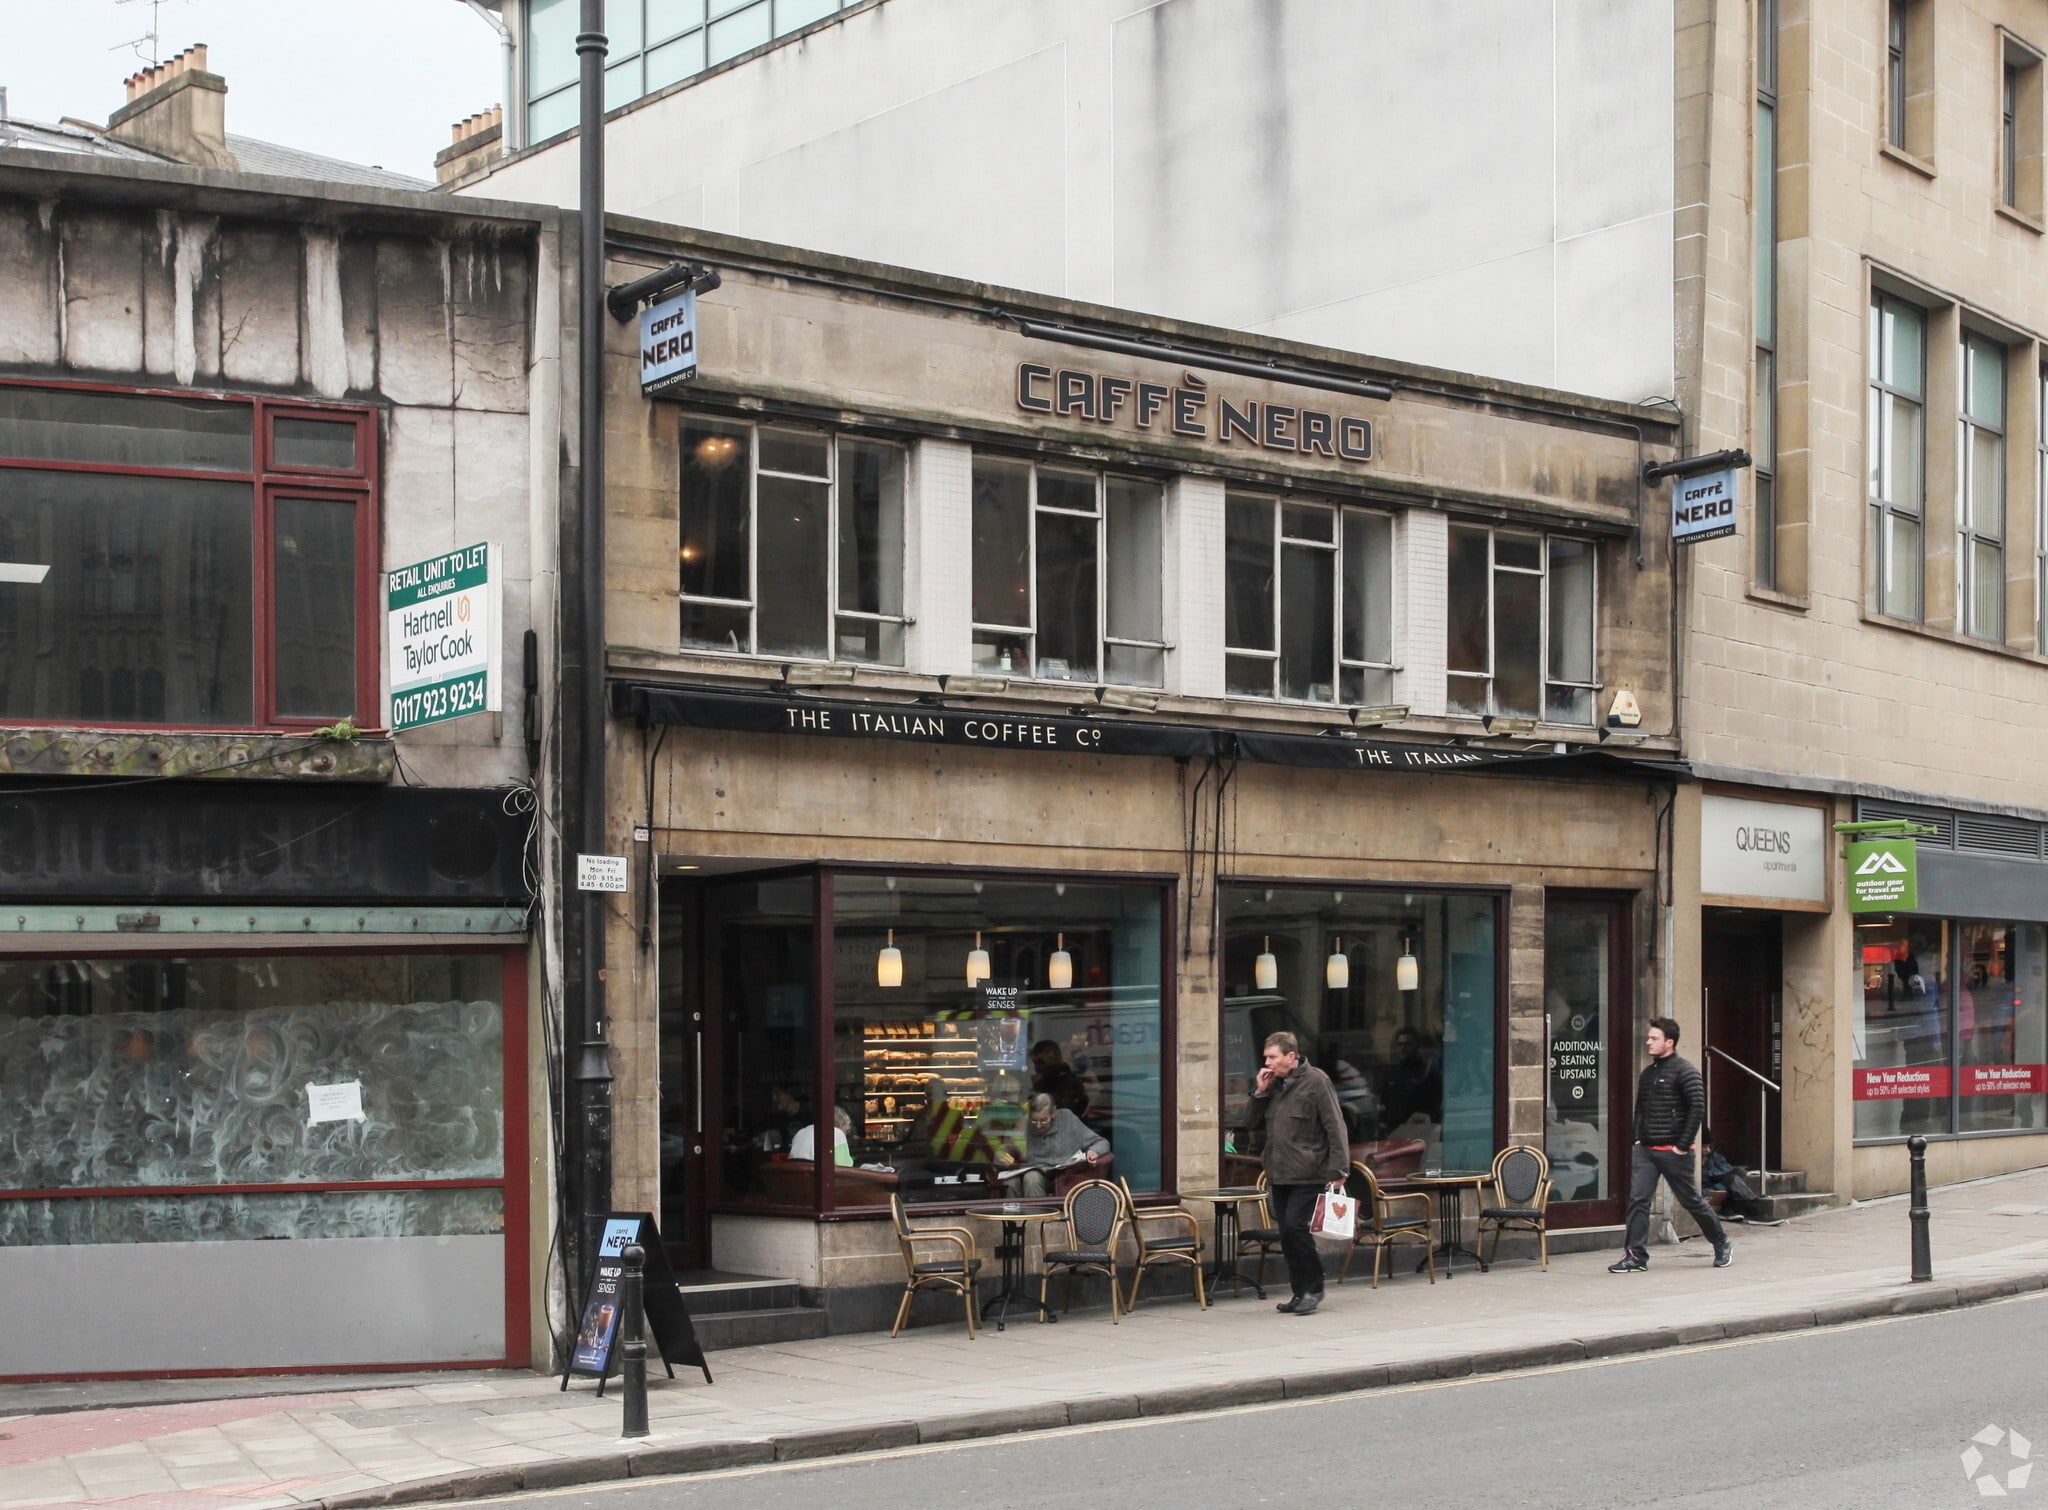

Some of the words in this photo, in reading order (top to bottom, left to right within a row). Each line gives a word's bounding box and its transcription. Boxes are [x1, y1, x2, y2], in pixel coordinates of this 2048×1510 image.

[650, 308, 684, 336] CAFFÈ
[643, 330, 693, 369] NERO
[644, 385, 653, 393] THE
[653, 379, 670, 390] ITALIAN
[671, 372, 686, 384] COFFEE
[1016, 362, 1207, 436] CAFFÈ
[1218, 396, 1373, 461] NERO
[1685, 481, 1723, 501] CAFFÈ
[1675, 498, 1733, 526] NERO
[1686, 533, 1705, 542] ITALIAN
[1706, 529, 1724, 538] COFFEE
[390, 567, 421, 592] RETAIL
[423, 558, 448, 581] UNIT
[450, 553, 463, 574] TO
[467, 545, 486, 569] LET
[417, 588, 427, 599] ALL
[428, 578, 456, 595] ENQUIRIES
[404, 600, 453, 638] Hartnell
[394, 693, 422, 725] 0117
[423, 687, 447, 719] 923
[450, 678, 483, 712] 9234
[787, 708, 831, 730] THE
[852, 713, 944, 736] ITALIAN
[964, 721, 1056, 744] COFFEE
[1355, 749, 1393, 765] THE
[1404, 751, 1482, 765] ITALIAN
[1736, 826, 1790, 854] QUEENS
[597, 858, 619, 866] loading
[1868, 886, 1889, 894] travel
[985, 987, 1007, 996] WAKE
[1008, 987, 1018, 995] UP
[987, 1000, 1015, 1009] SENSES
[1553, 1041, 1604, 1051] ADDITIONAL
[1561, 1055, 1595, 1065] SEATING
[1560, 1069, 1596, 1079] UPSTAIRS
[1866, 1072, 1881, 1084] New
[1882, 1072, 1896, 1083] Year
[1897, 1071, 1930, 1082] Reductions
[1975, 1069, 1988, 1080] New
[1988, 1068, 2001, 1079] Year
[2001, 1067, 2031, 1079] Reductions
[1866, 1089, 1873, 1097] up
[1873, 1087, 1879, 1095] to
[1880, 1085, 1890, 1095] 50%
[1890, 1085, 1898, 1094] off
[1897, 1084, 1916, 1094] selected
[1917, 1084, 1930, 1095] styles
[1975, 1084, 1981, 1092] up
[2019, 1081, 2031, 1090] styles
[600, 1267, 614, 1277] WAKE
[614, 1267, 622, 1277] UP
[597, 1283, 616, 1294] SENSES
